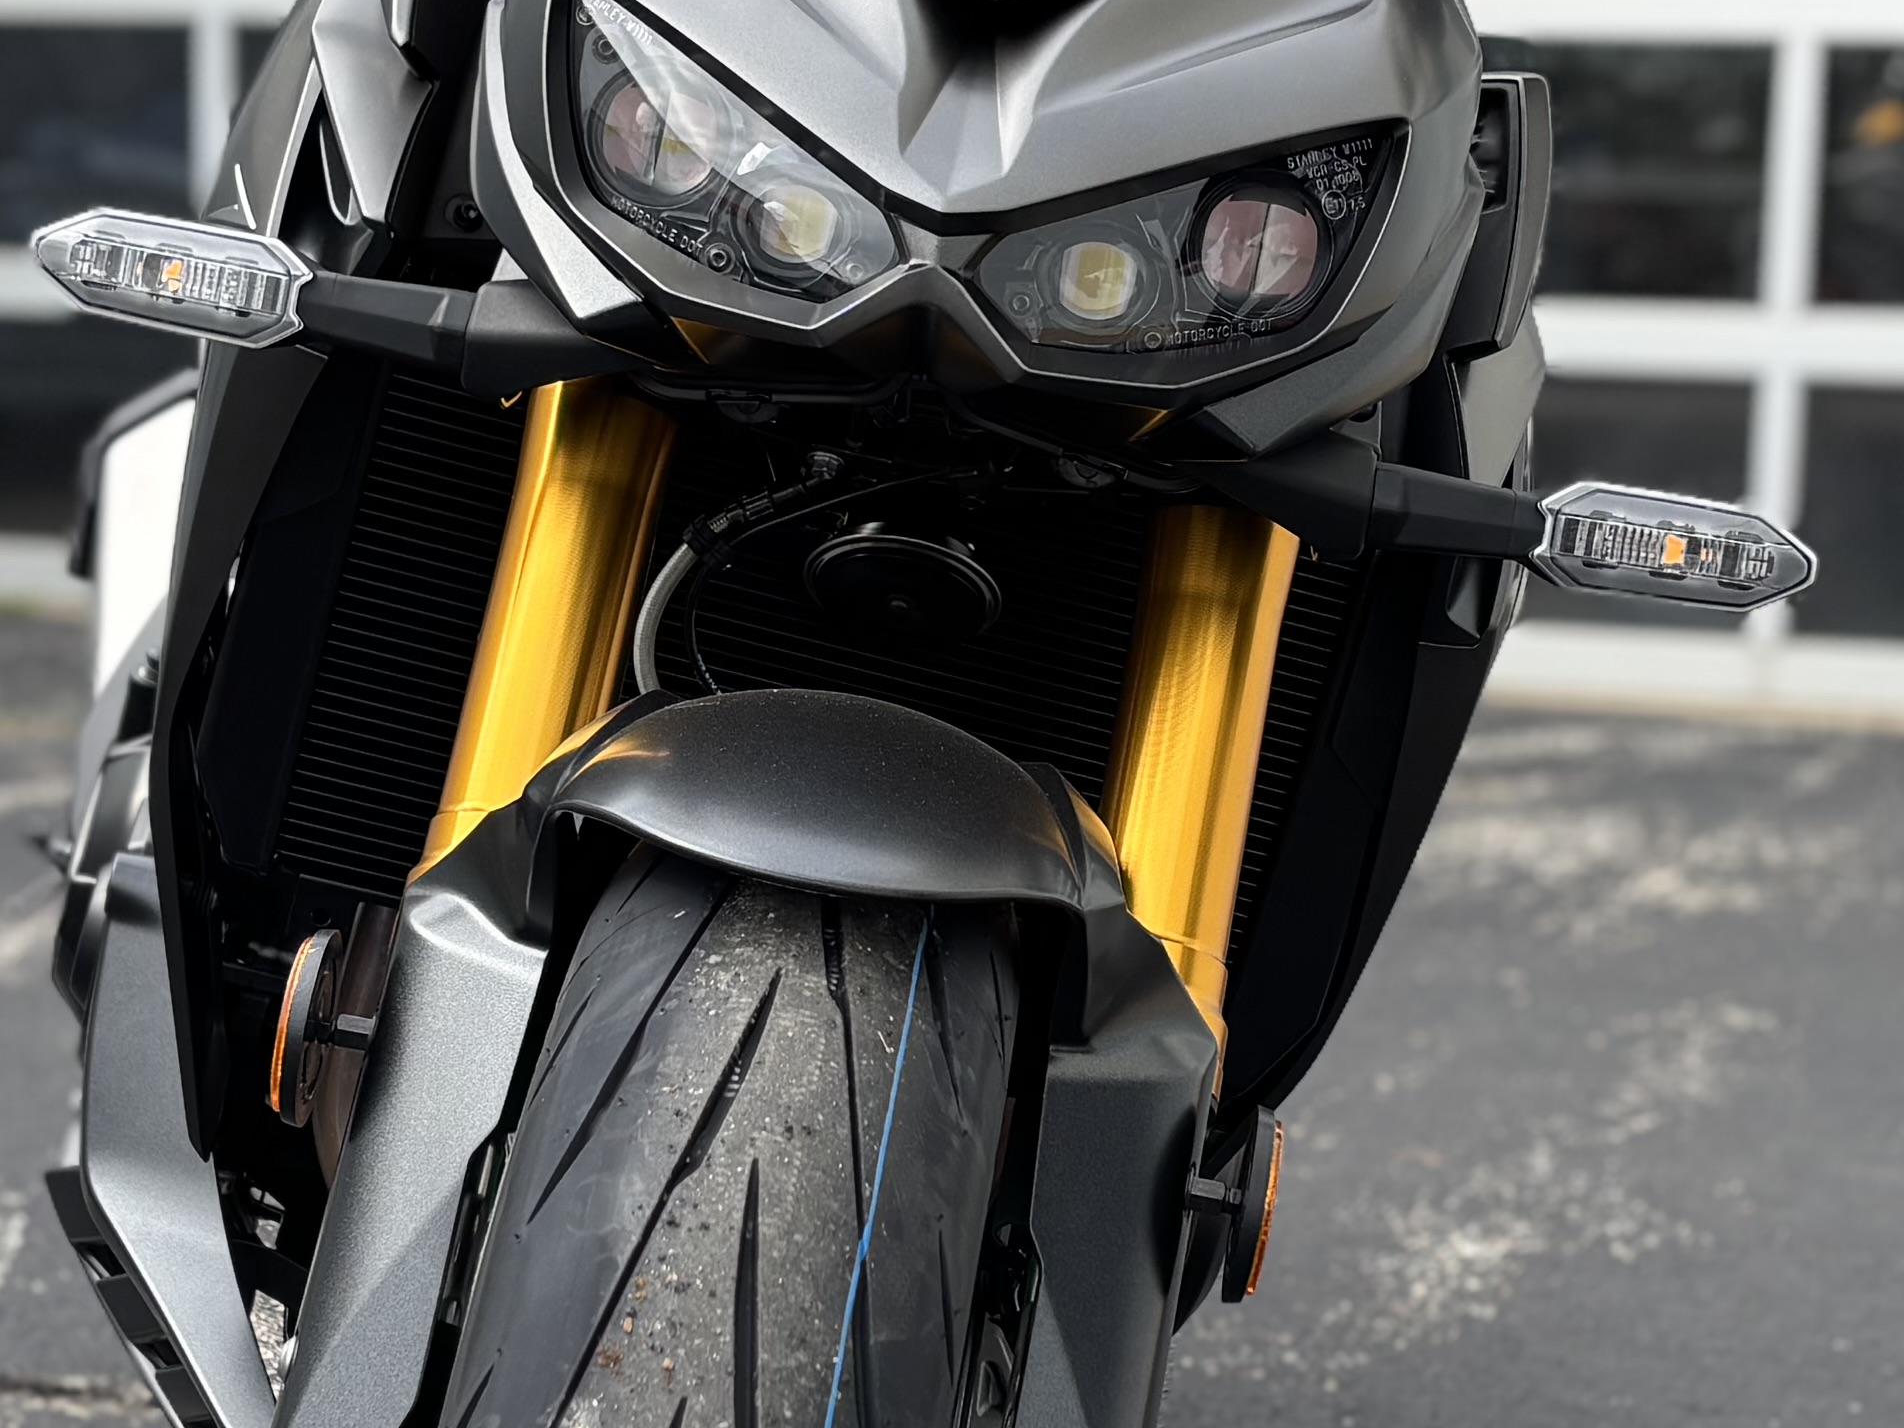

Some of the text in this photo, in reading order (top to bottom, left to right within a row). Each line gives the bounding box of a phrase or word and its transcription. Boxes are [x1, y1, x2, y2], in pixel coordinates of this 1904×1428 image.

[610, 195, 703, 256] MOTORCYCLE DOT
[1165, 322, 1245, 346] MOTORCYCLE
